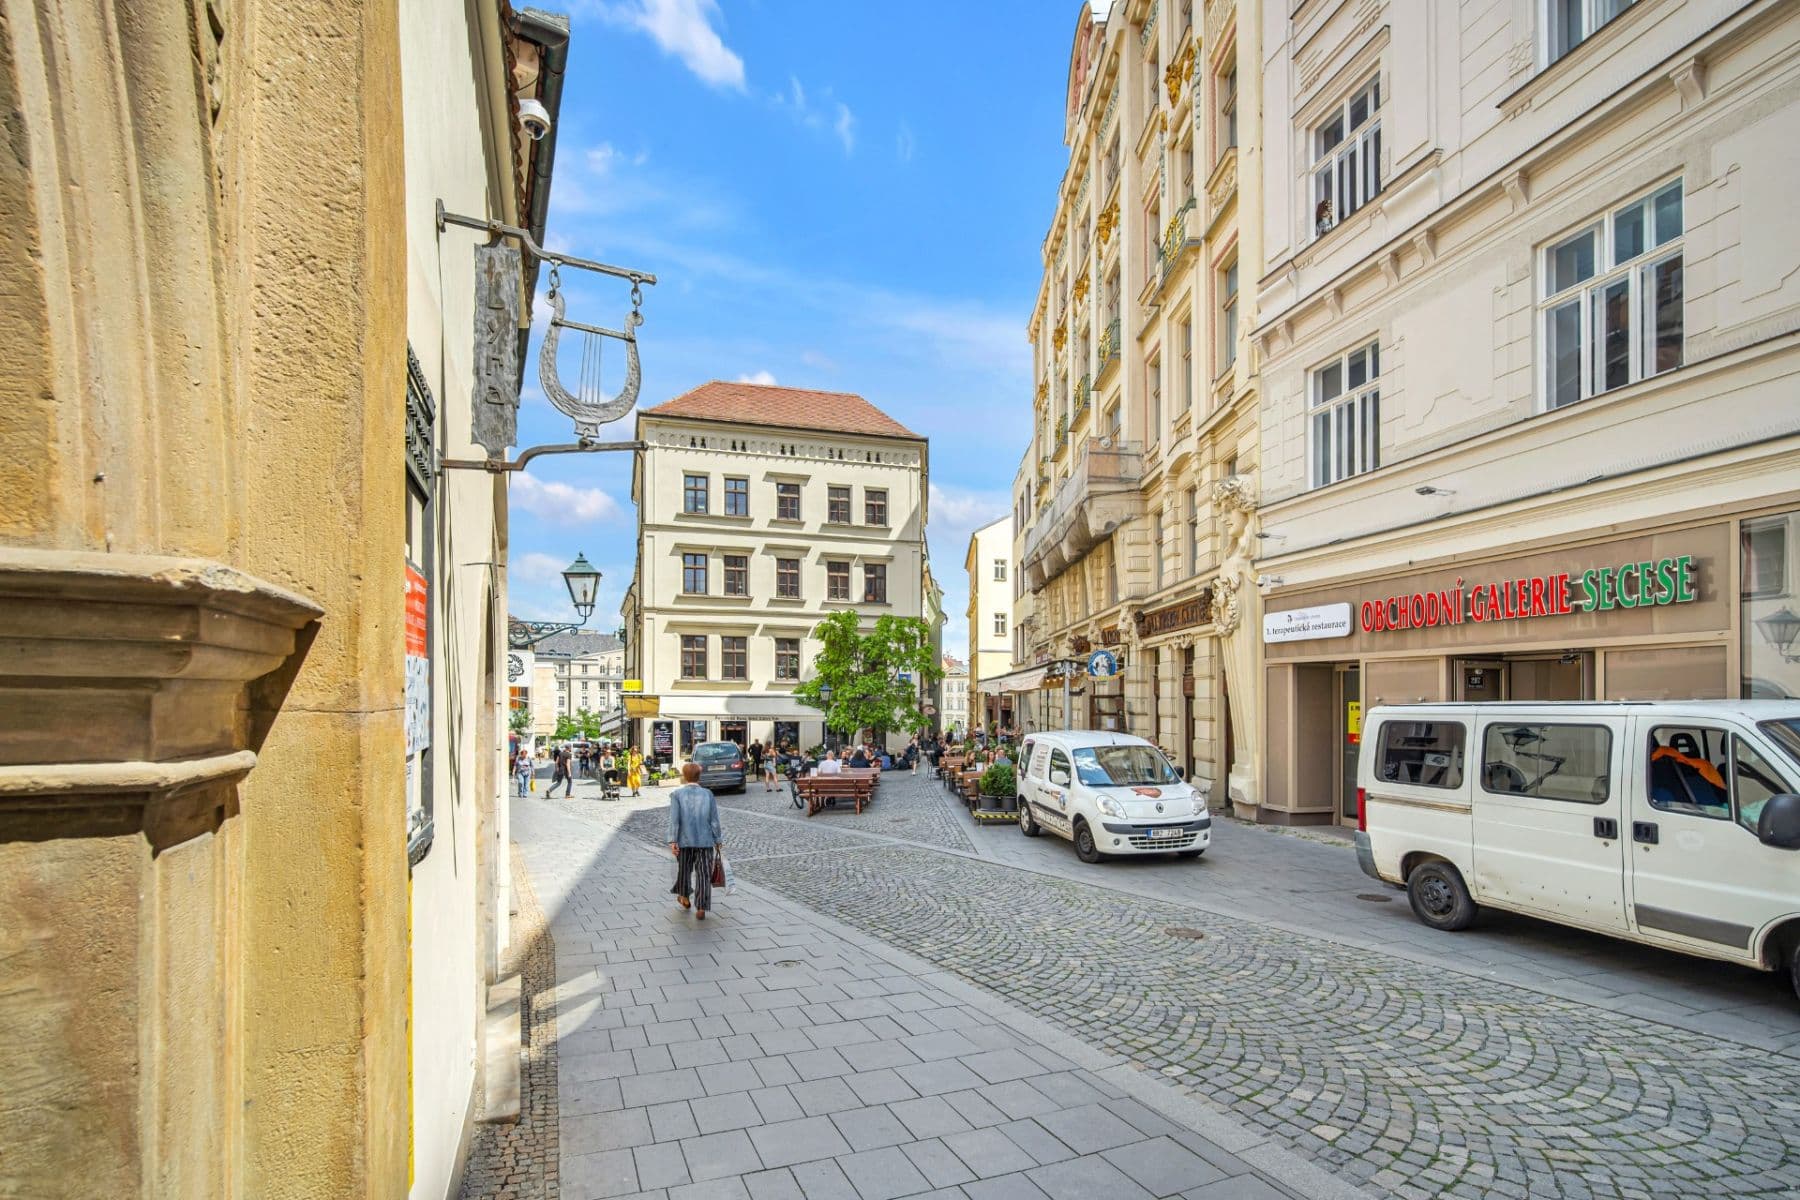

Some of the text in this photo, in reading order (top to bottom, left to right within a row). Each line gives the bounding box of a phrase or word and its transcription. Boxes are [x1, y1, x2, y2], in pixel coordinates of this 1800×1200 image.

[1361, 555, 1698, 633] OBCHODNÍ GALERIE SECESE
[1272, 622, 1310, 637] terapeutická
[1311, 620, 1347, 631] restaurace
